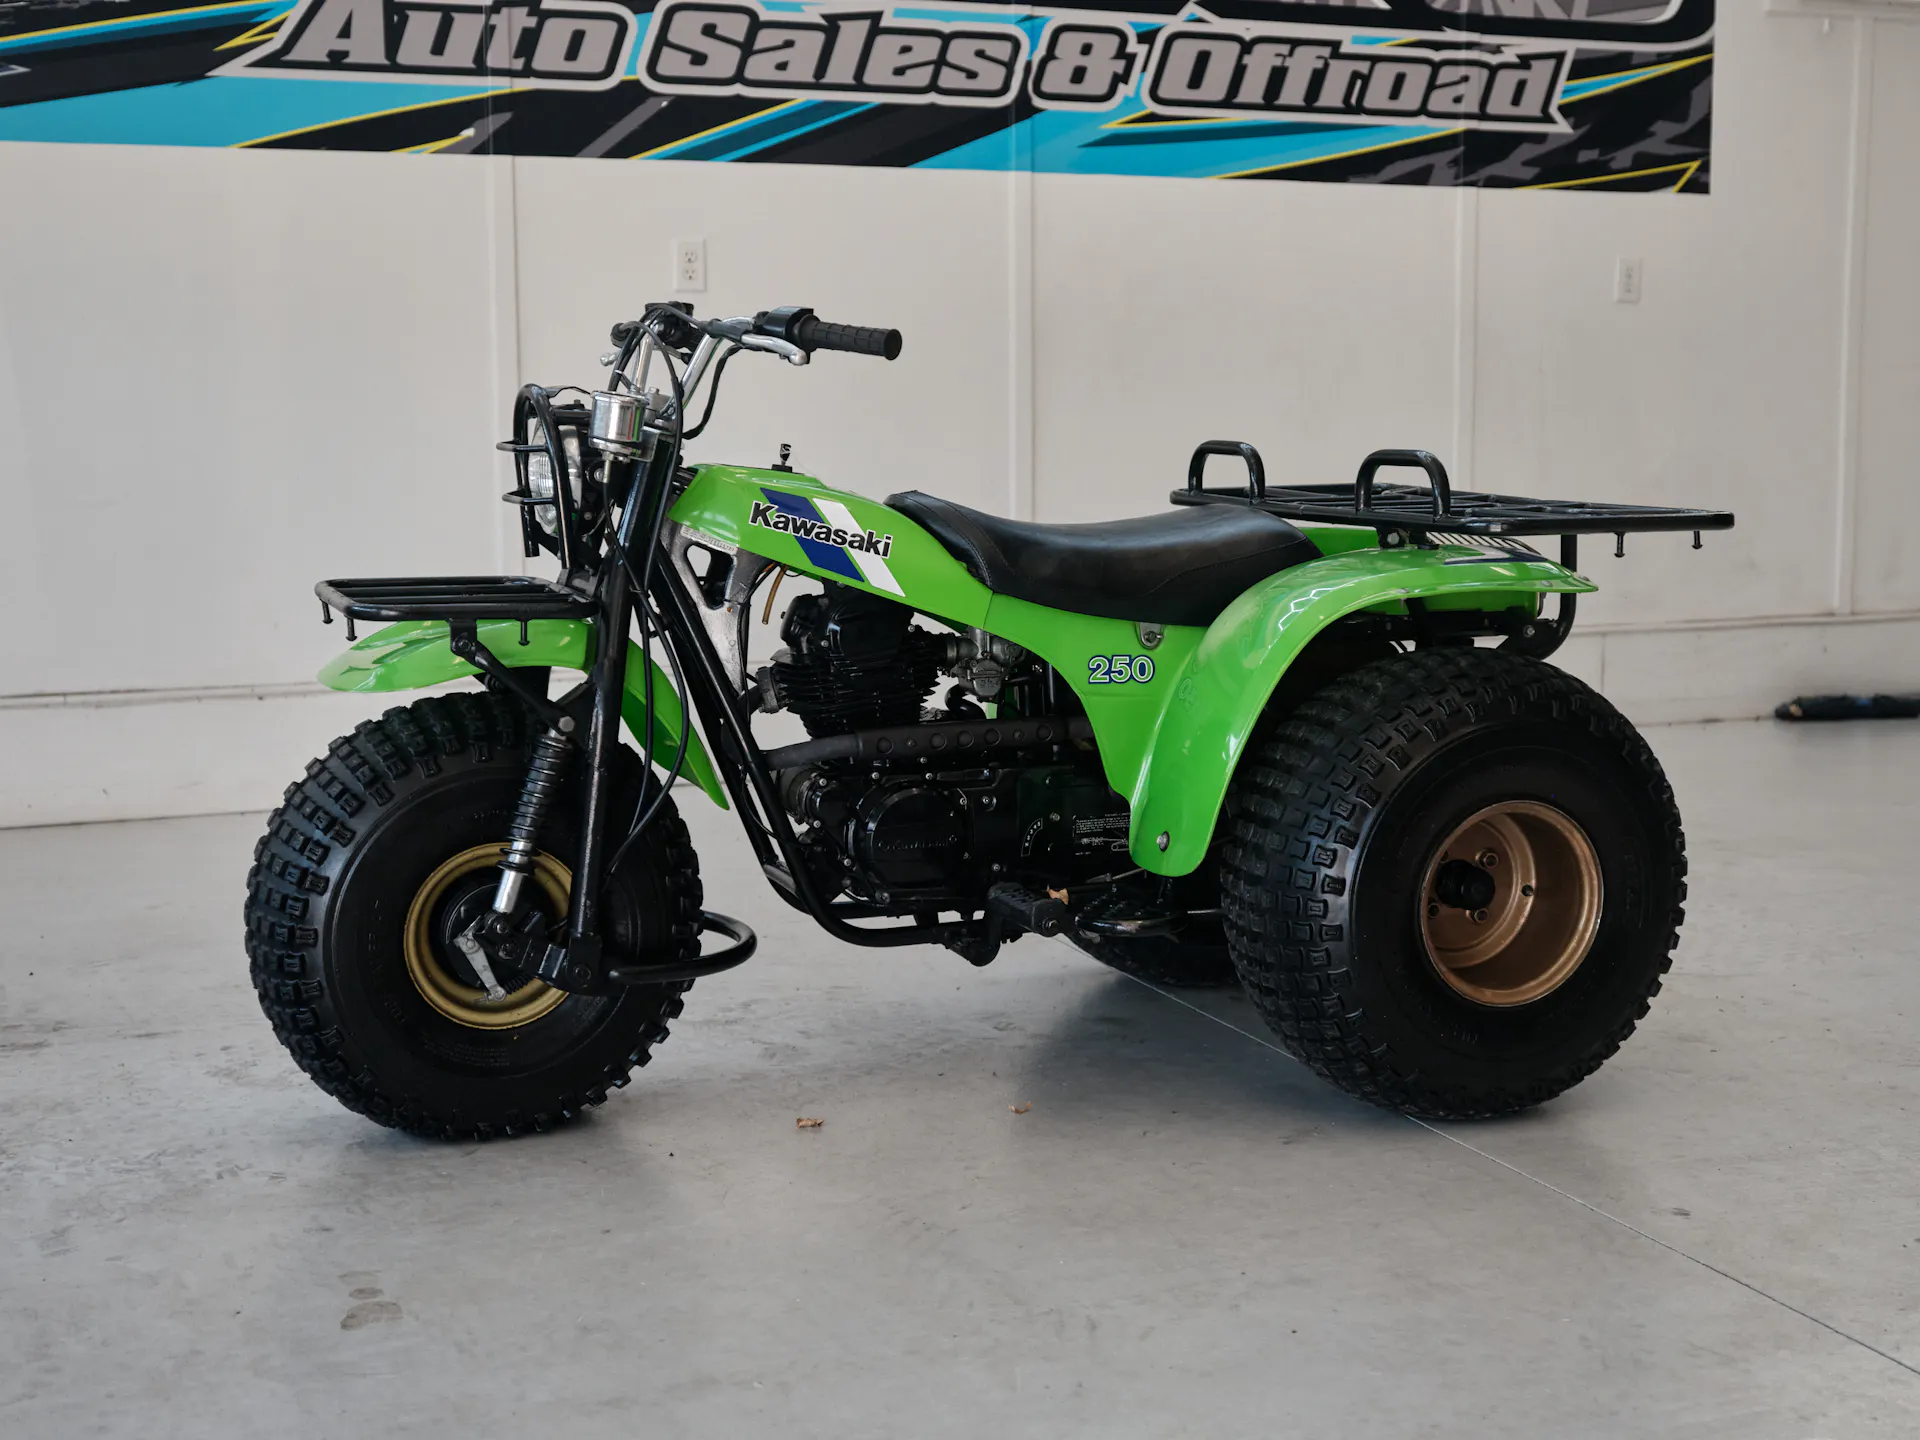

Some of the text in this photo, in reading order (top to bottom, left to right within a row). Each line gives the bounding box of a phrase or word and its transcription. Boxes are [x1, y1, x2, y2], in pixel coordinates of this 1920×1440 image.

[293, 0, 1562, 118] Auto Sales & Offroad
[749, 500, 894, 559] Kawasaki
[1088, 654, 1155, 684] 250
